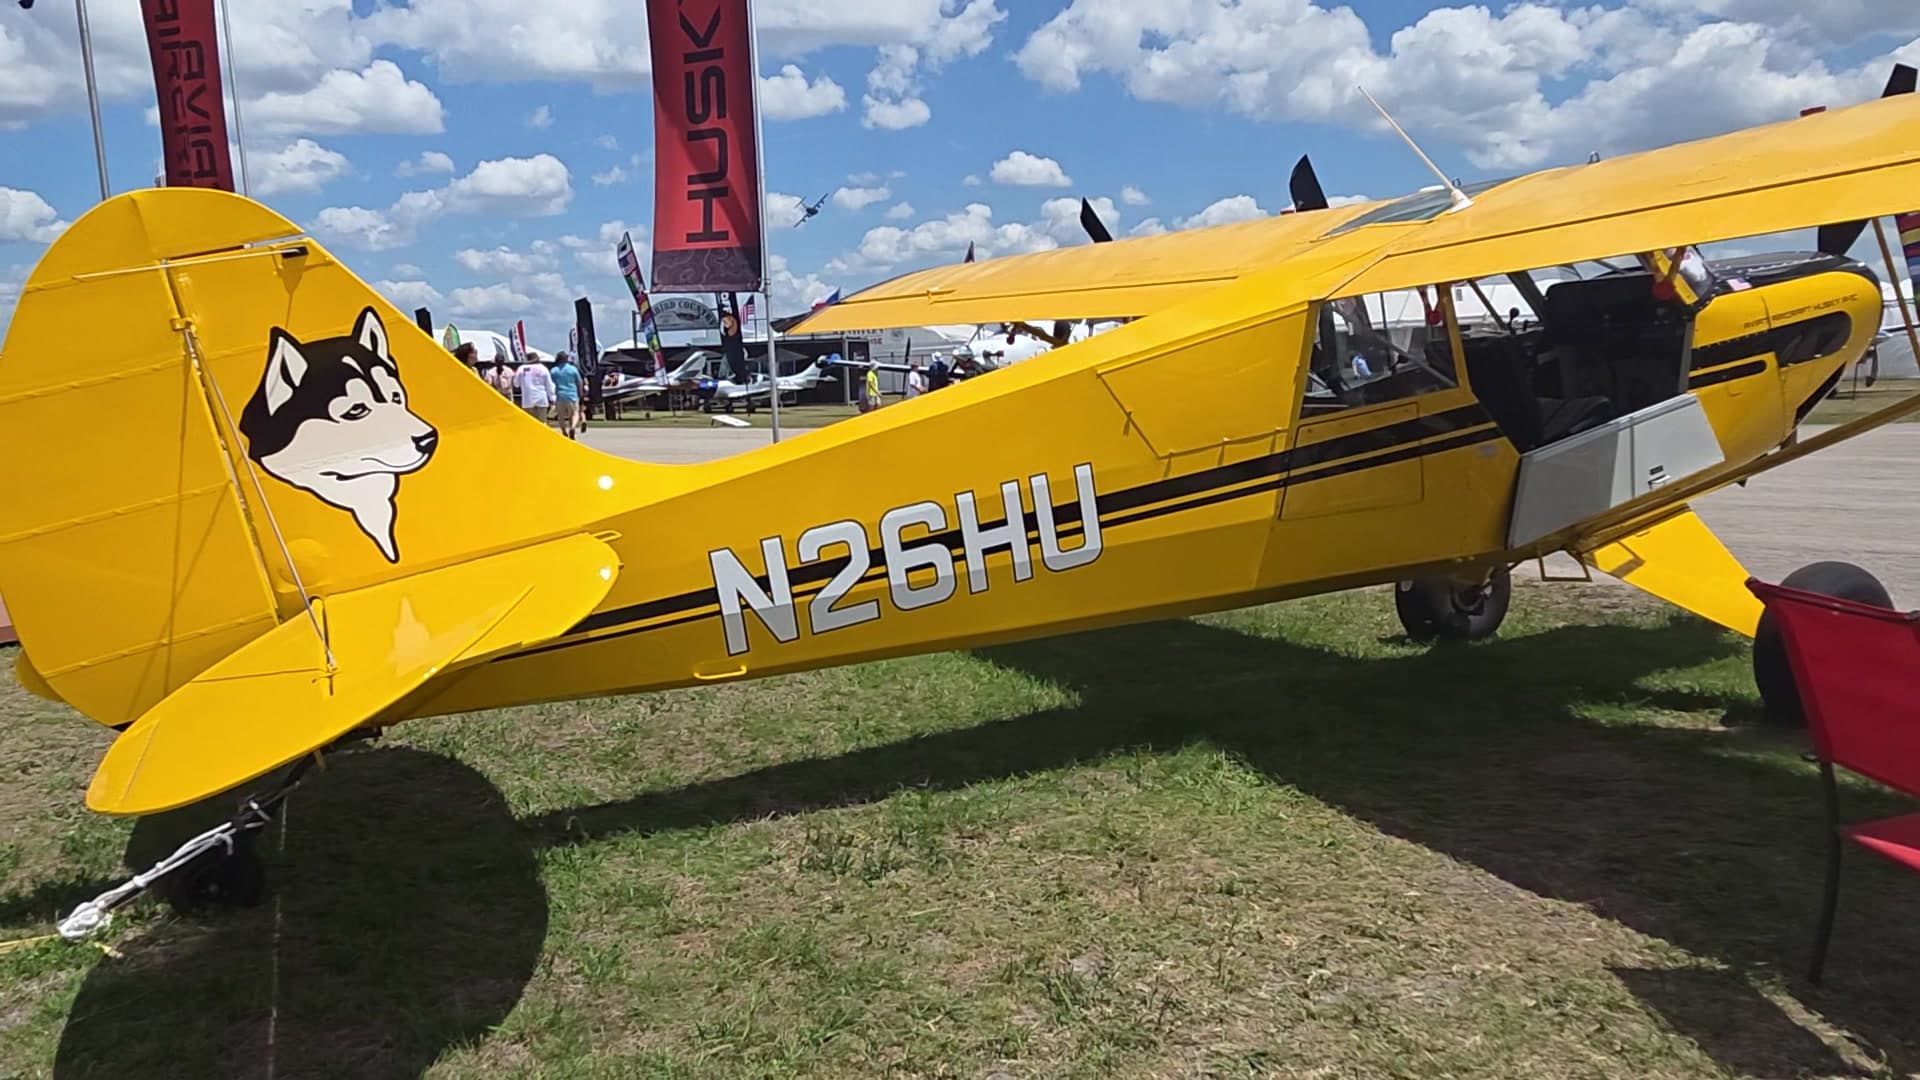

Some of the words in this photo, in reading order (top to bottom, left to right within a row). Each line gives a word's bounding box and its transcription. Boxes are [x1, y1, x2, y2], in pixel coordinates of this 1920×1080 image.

[184, 40, 218, 187] AVIA
[678, 0, 730, 244] HUSK
[708, 462, 1104, 657] N26HU
